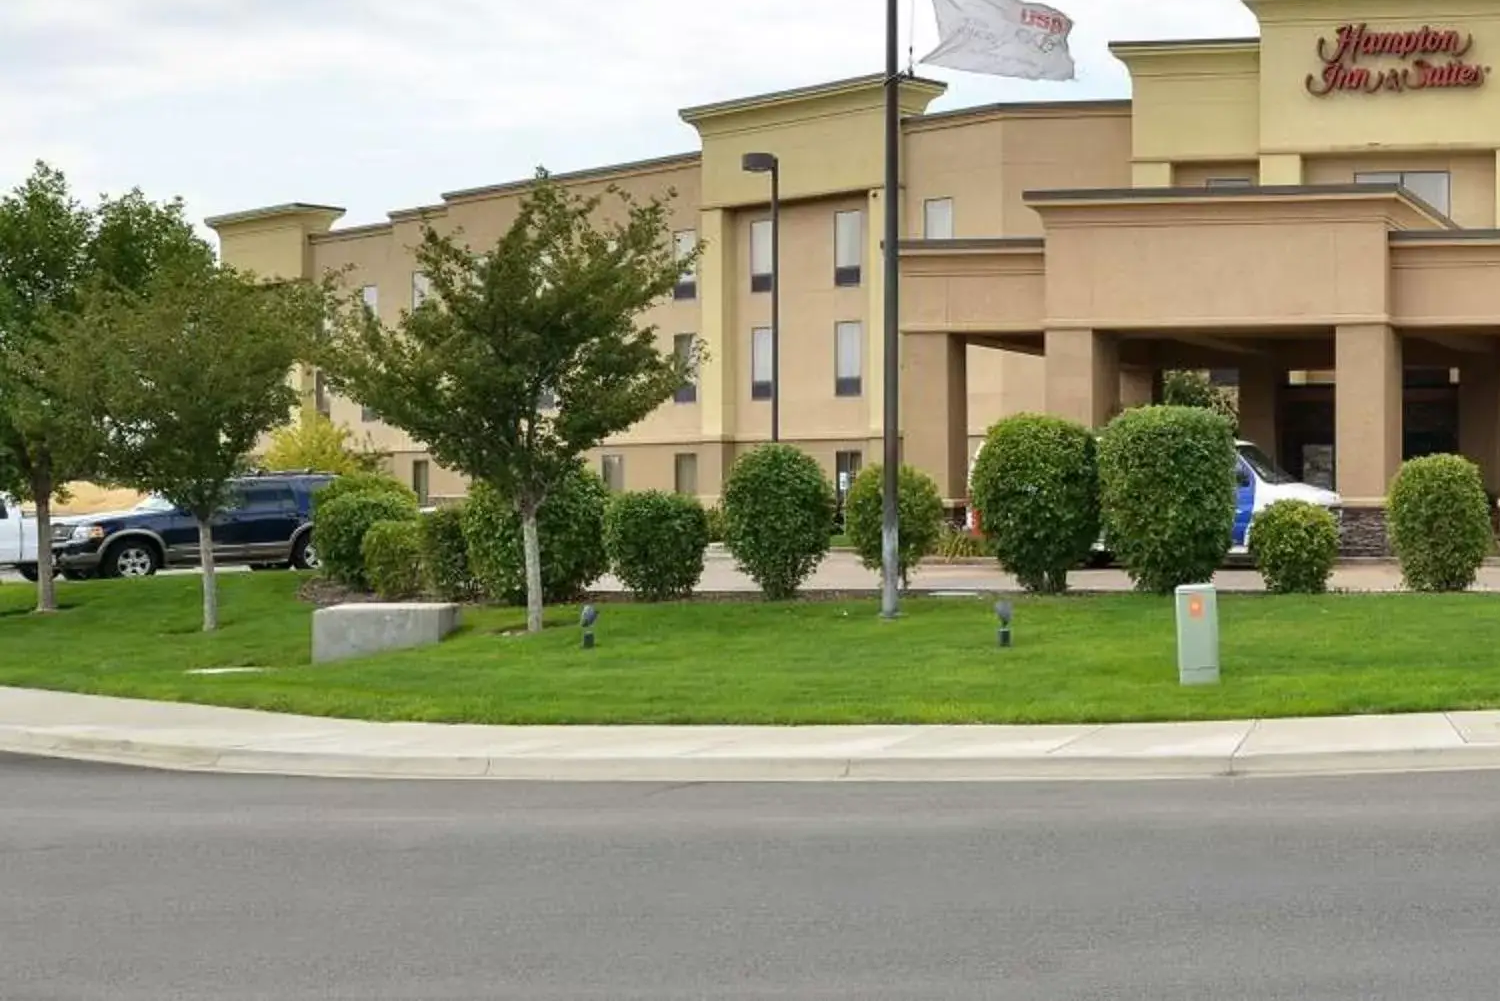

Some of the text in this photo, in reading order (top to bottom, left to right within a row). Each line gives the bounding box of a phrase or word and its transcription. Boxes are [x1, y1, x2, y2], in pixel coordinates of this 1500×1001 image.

[1317, 23, 1473, 64] Hampton
[1305, 59, 1485, 97] Inn & Suites
